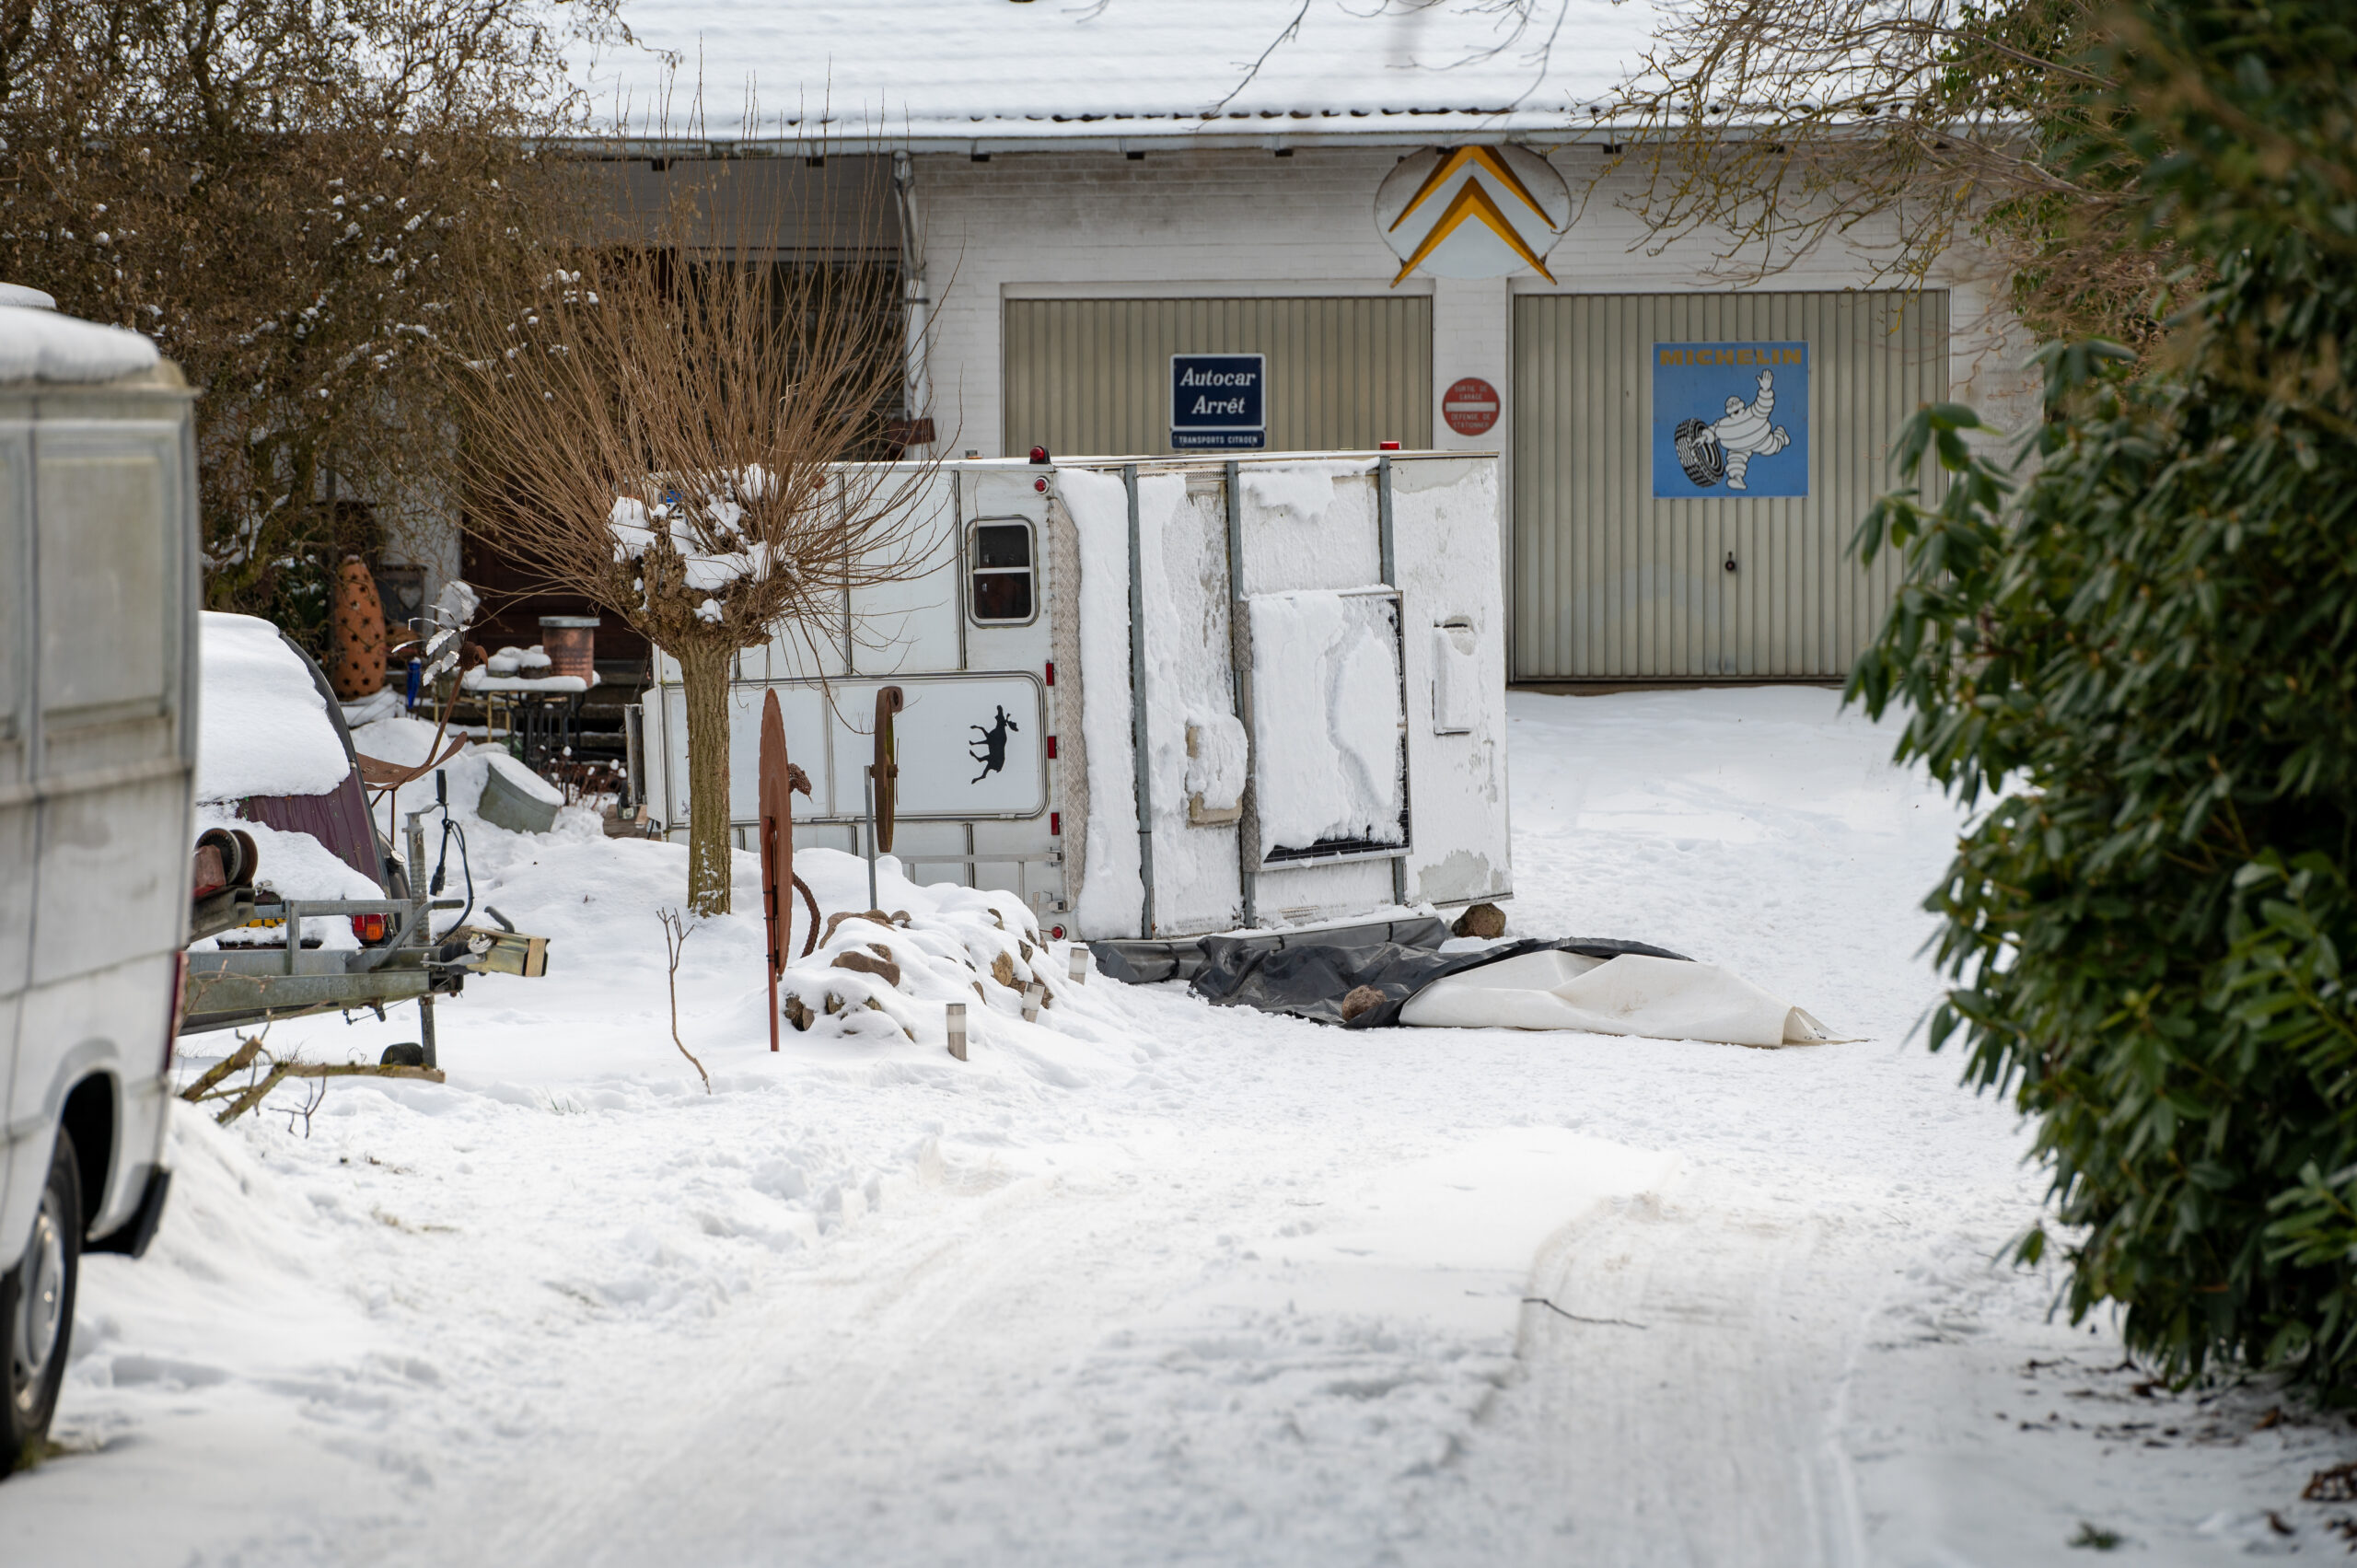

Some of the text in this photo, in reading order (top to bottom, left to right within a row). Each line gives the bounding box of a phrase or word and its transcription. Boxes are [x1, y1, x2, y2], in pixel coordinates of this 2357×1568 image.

[1659, 348, 1802, 366] MICHELIN
[1179, 367, 1256, 387] Autocar
[1191, 394, 1246, 414] Arrêt
[1178, 436, 1225, 444] TRANSPORTS
